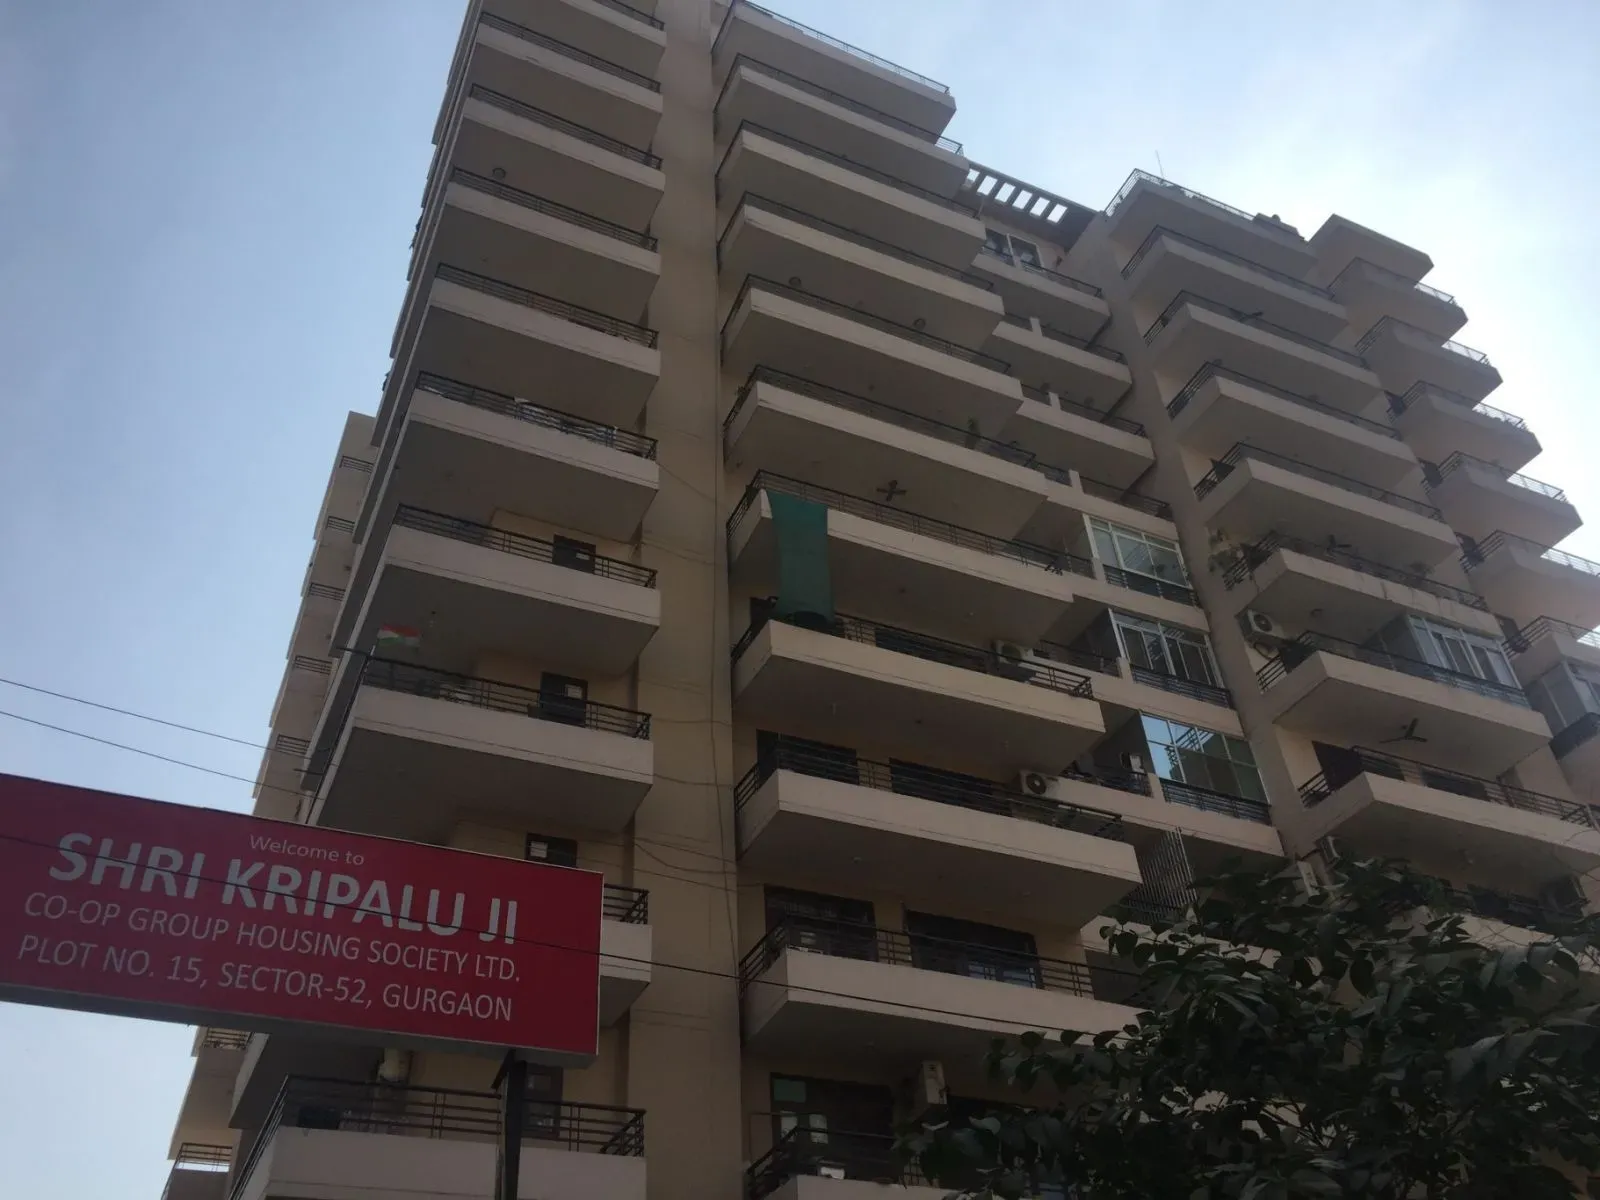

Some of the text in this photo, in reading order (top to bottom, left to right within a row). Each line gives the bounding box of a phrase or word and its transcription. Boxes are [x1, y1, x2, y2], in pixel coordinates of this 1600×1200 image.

[49, 832, 518, 945] SHRI KRIPALU JI
[249, 833, 365, 867] Welcome to
[17, 935, 512, 1022] PLOT NO. 15, SECTOR-52, GURGAON
[24, 892, 520, 982] CO-OP GROUP HOUSING SOCIETY LTD.
